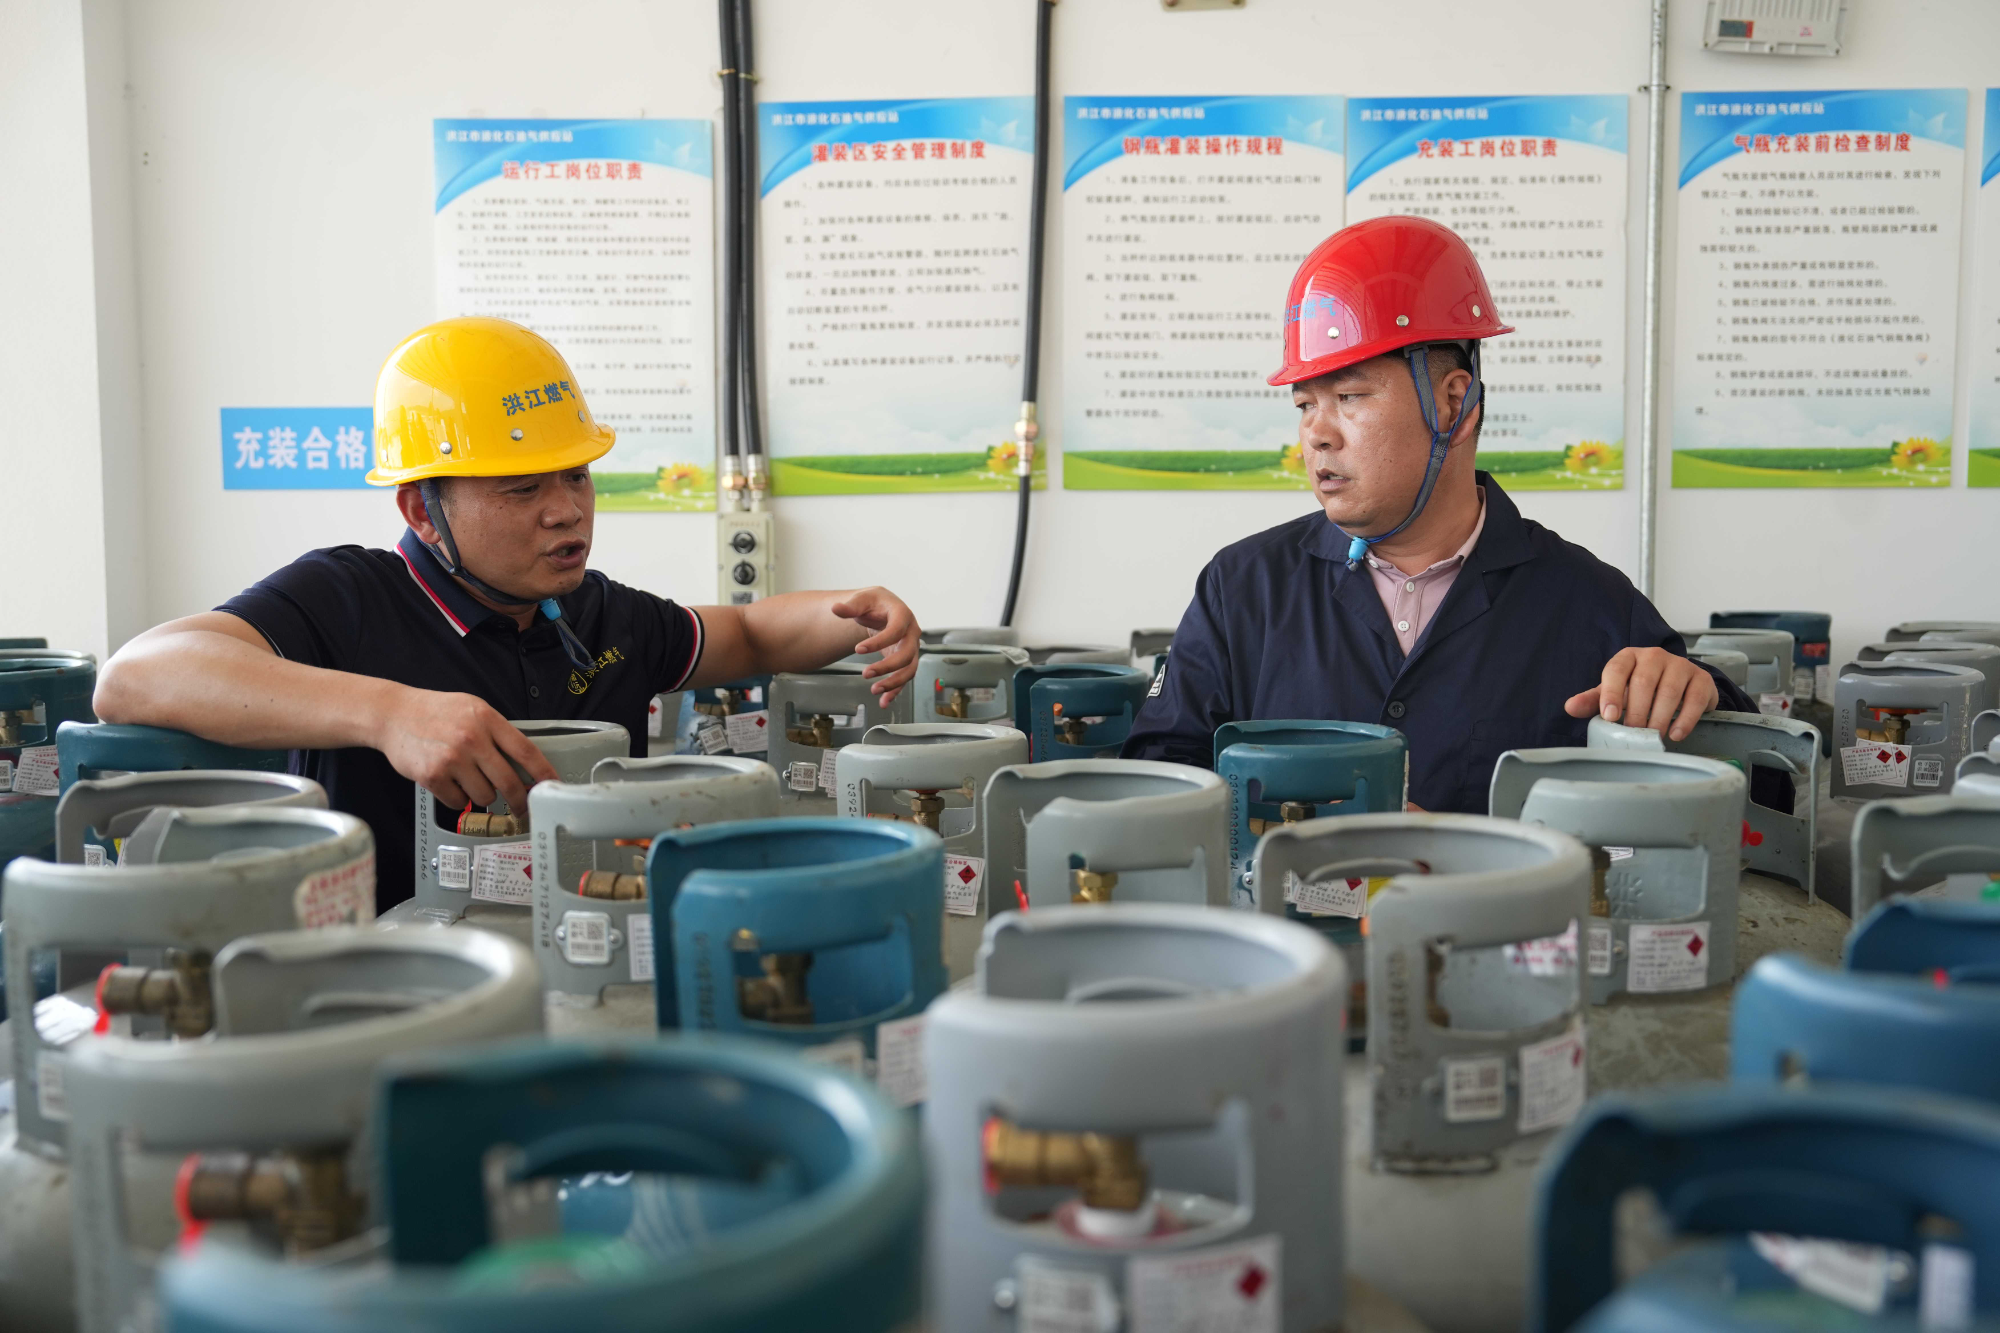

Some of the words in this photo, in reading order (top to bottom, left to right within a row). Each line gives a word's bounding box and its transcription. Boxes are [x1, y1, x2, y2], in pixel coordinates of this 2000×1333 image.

[1694, 102, 1825, 116] 洪江市液化石油气供应站
[811, 140, 987, 163] 灌装区安全管理制度
[1122, 136, 1284, 156] 钢瓶灌装操作规程
[1416, 138, 1559, 158] 充装工岗位职责
[1733, 132, 1912, 154] 气瓶充装前检查制度
[502, 160, 644, 181] 运行工岗位职责
[501, 379, 576, 417] 洪江燃气
[233, 425, 376, 470] 充装合格
